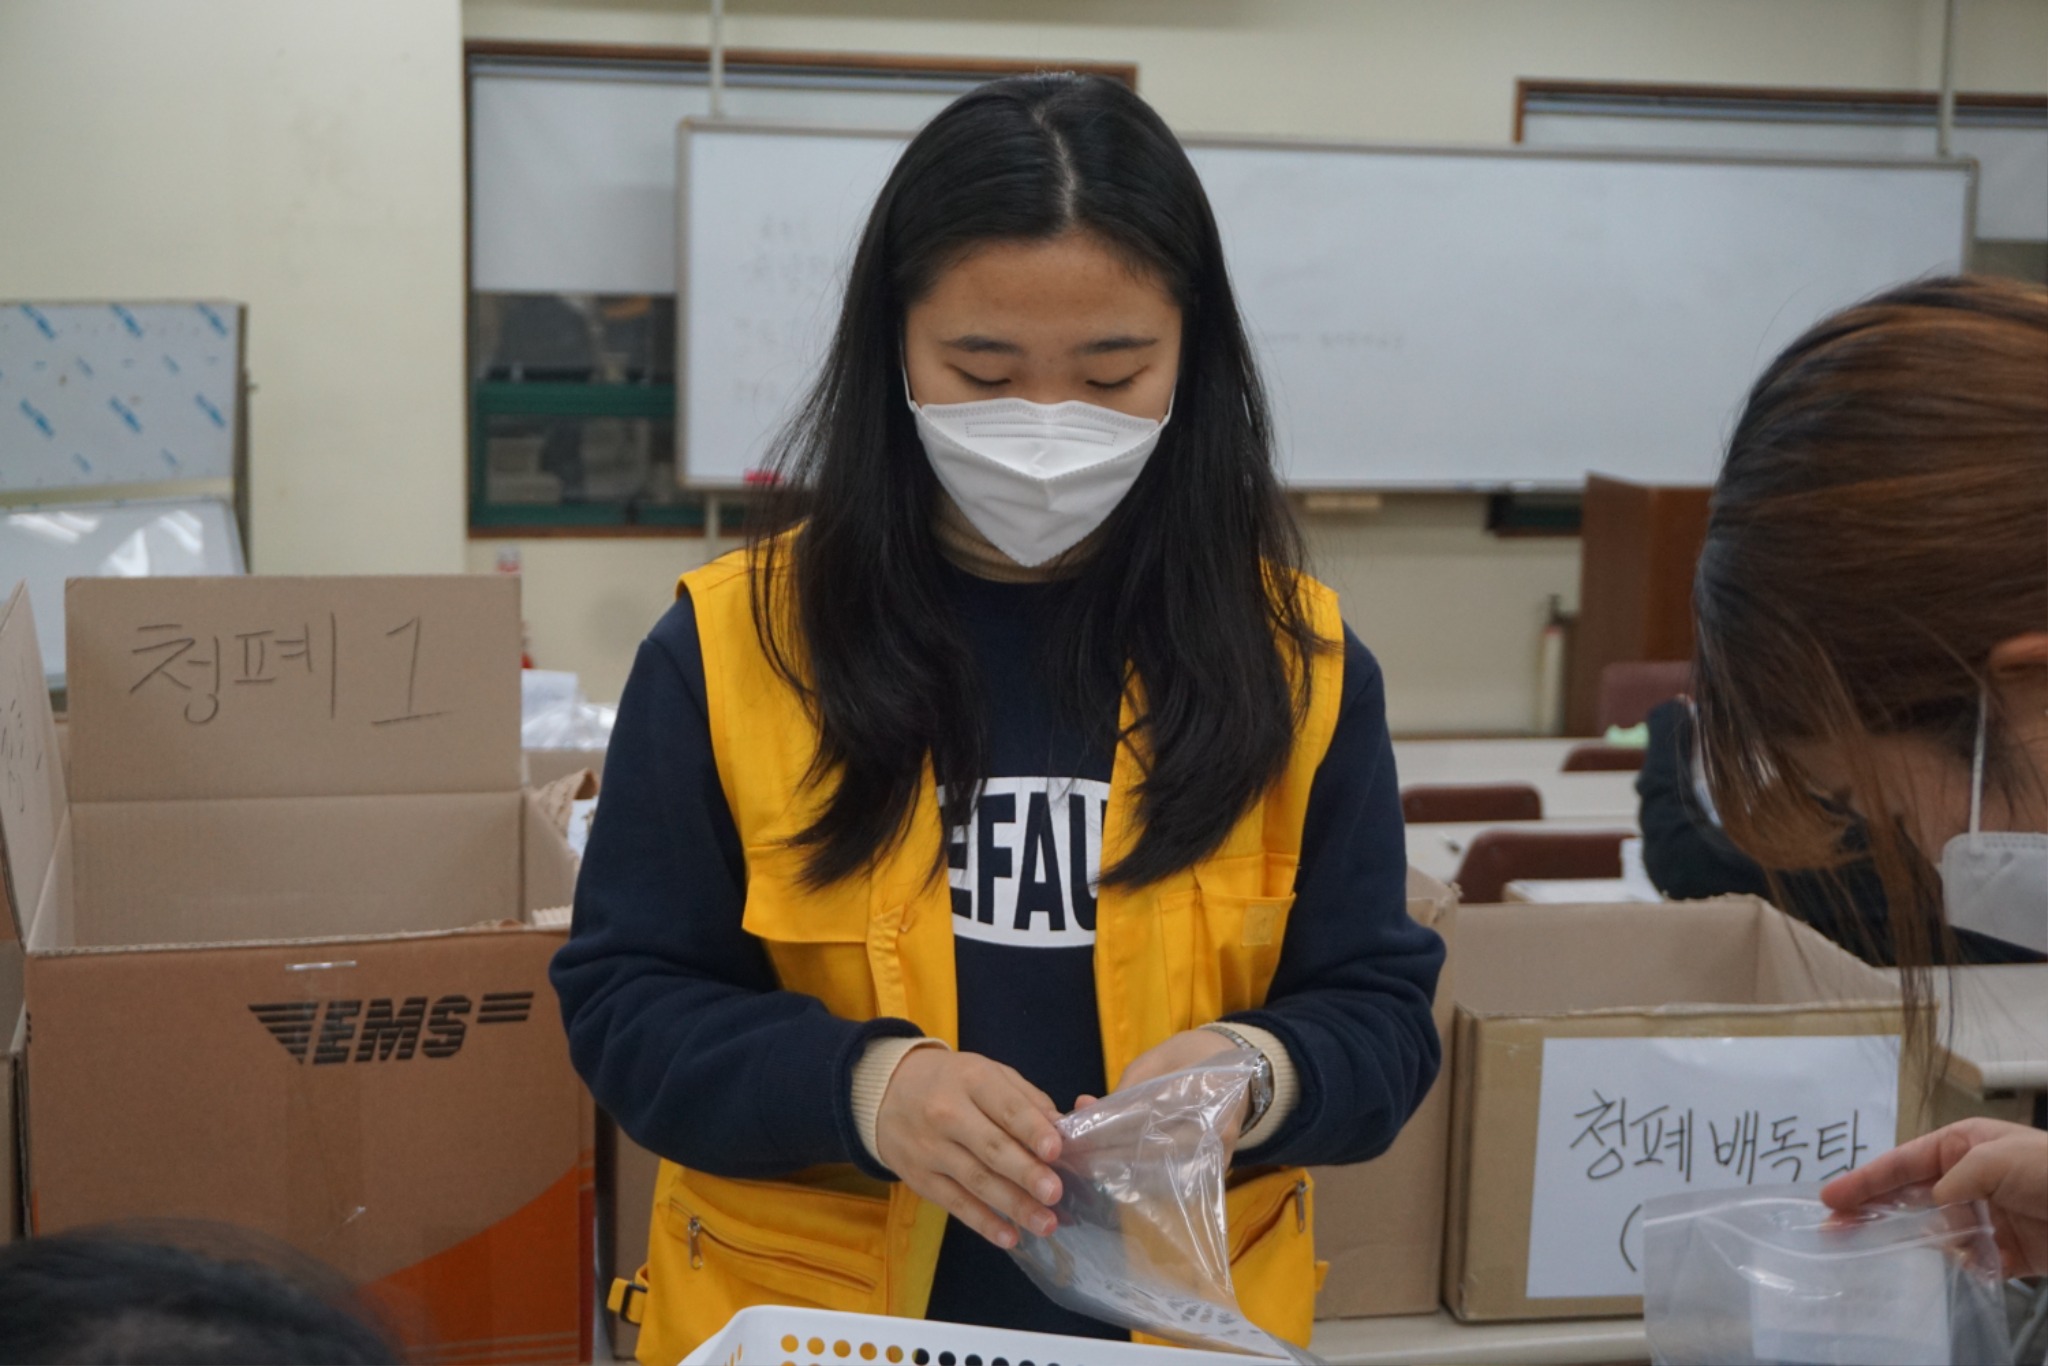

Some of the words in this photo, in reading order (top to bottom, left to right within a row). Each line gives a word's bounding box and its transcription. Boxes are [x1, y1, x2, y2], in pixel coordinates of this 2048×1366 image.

[130, 612, 336, 724] 청폐
[371, 616, 453, 726] 1
[313, 994, 472, 1066] EMS
